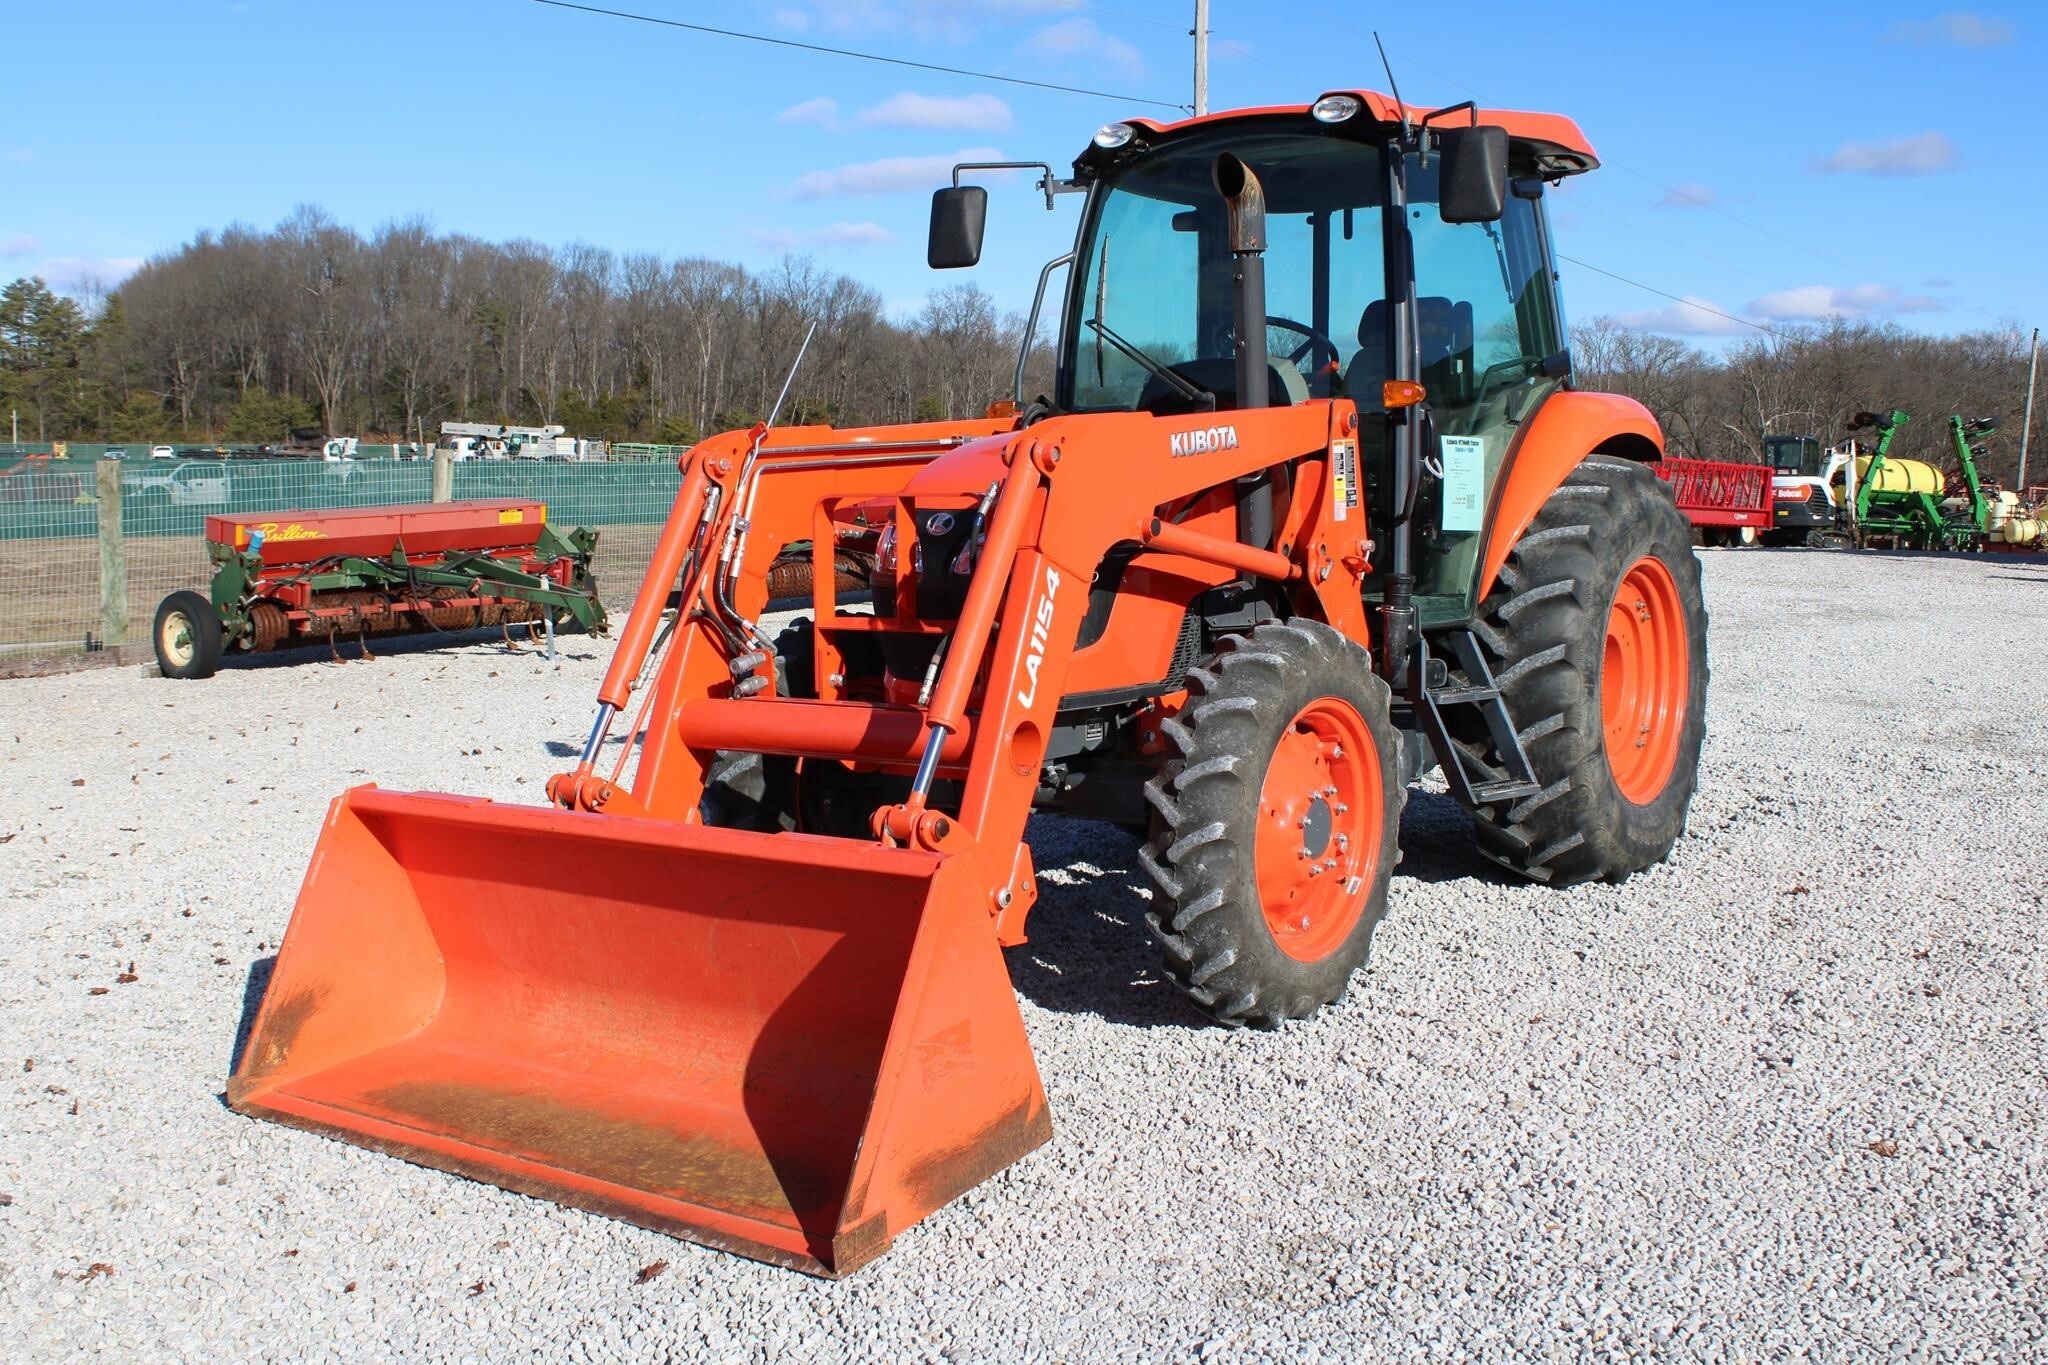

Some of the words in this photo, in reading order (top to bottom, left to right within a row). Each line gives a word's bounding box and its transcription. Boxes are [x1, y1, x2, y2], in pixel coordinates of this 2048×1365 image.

[1170, 425, 1239, 458] KUBOTA
[1777, 489, 1803, 498] Bobcat
[259, 523, 329, 543] Brillion
[1017, 566, 1061, 709] LA1154
